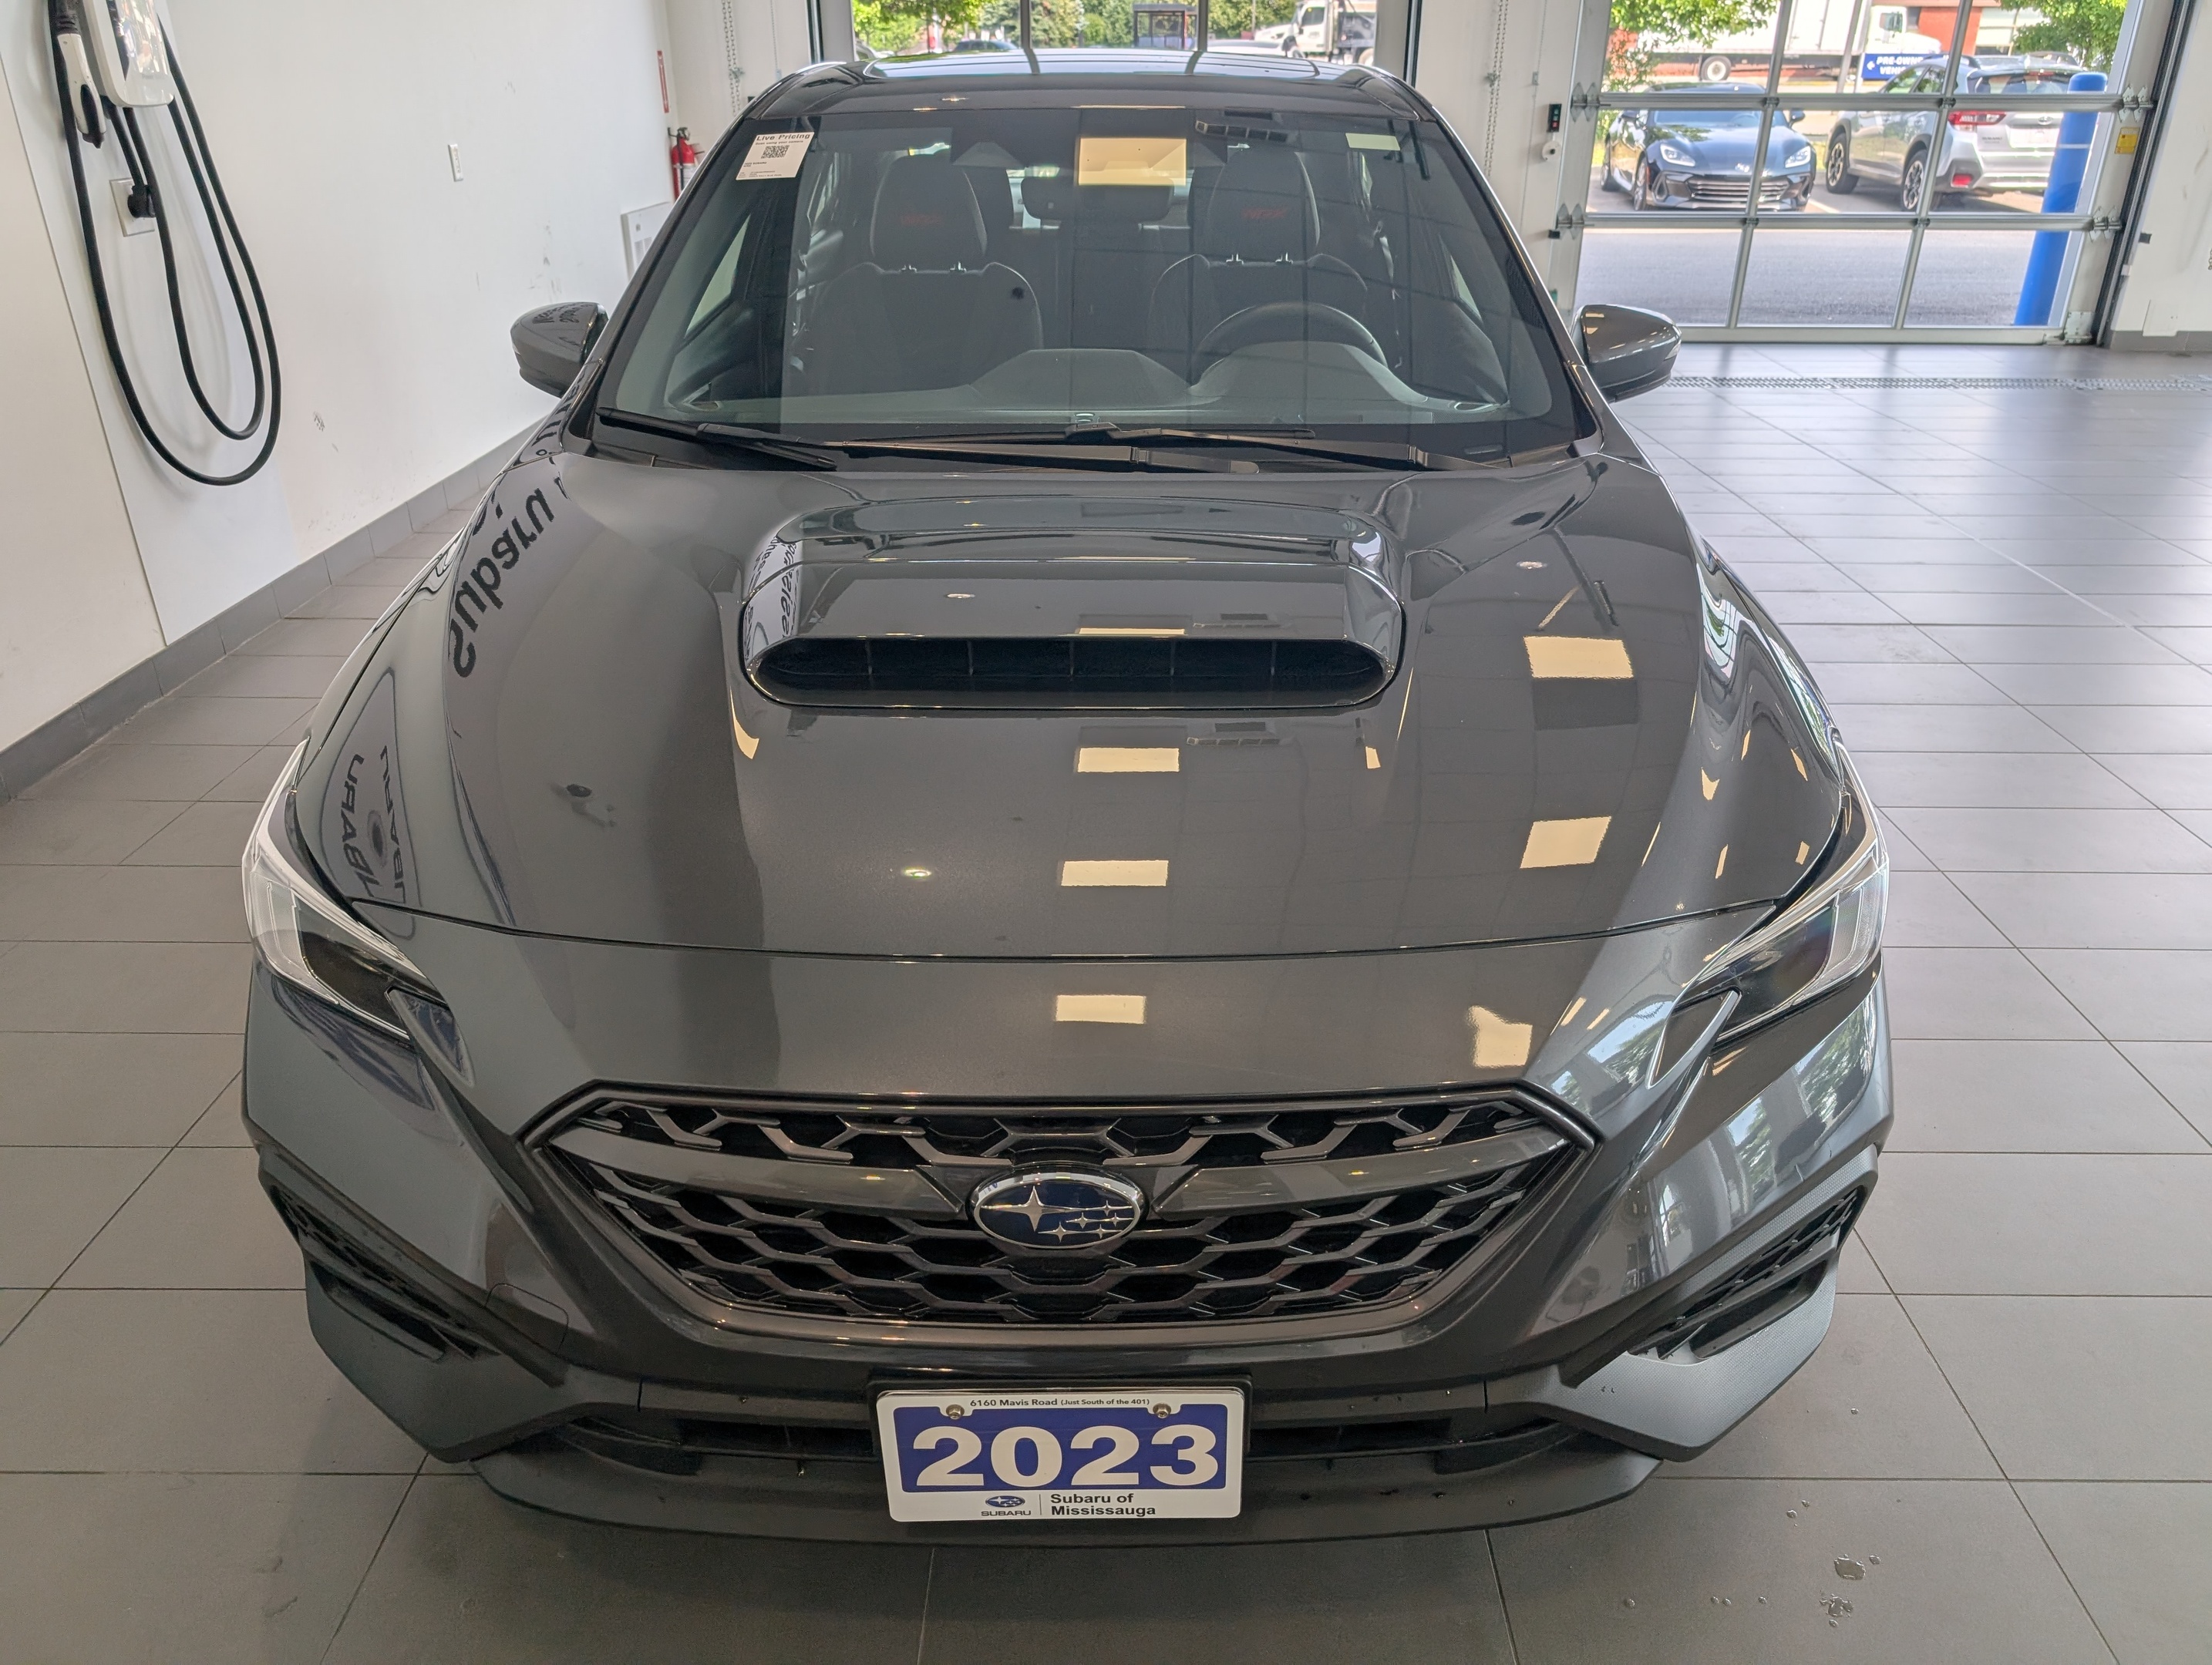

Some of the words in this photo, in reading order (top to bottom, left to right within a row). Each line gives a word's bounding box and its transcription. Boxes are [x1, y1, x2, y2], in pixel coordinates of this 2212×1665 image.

[1876, 56, 1924, 66] PRE-OWN
[913, 1424, 1219, 1487] 2023
[1050, 1493, 1111, 1504] Subaru
[1116, 1493, 1134, 1503] of
[1051, 1505, 1156, 1517] Mississauga
